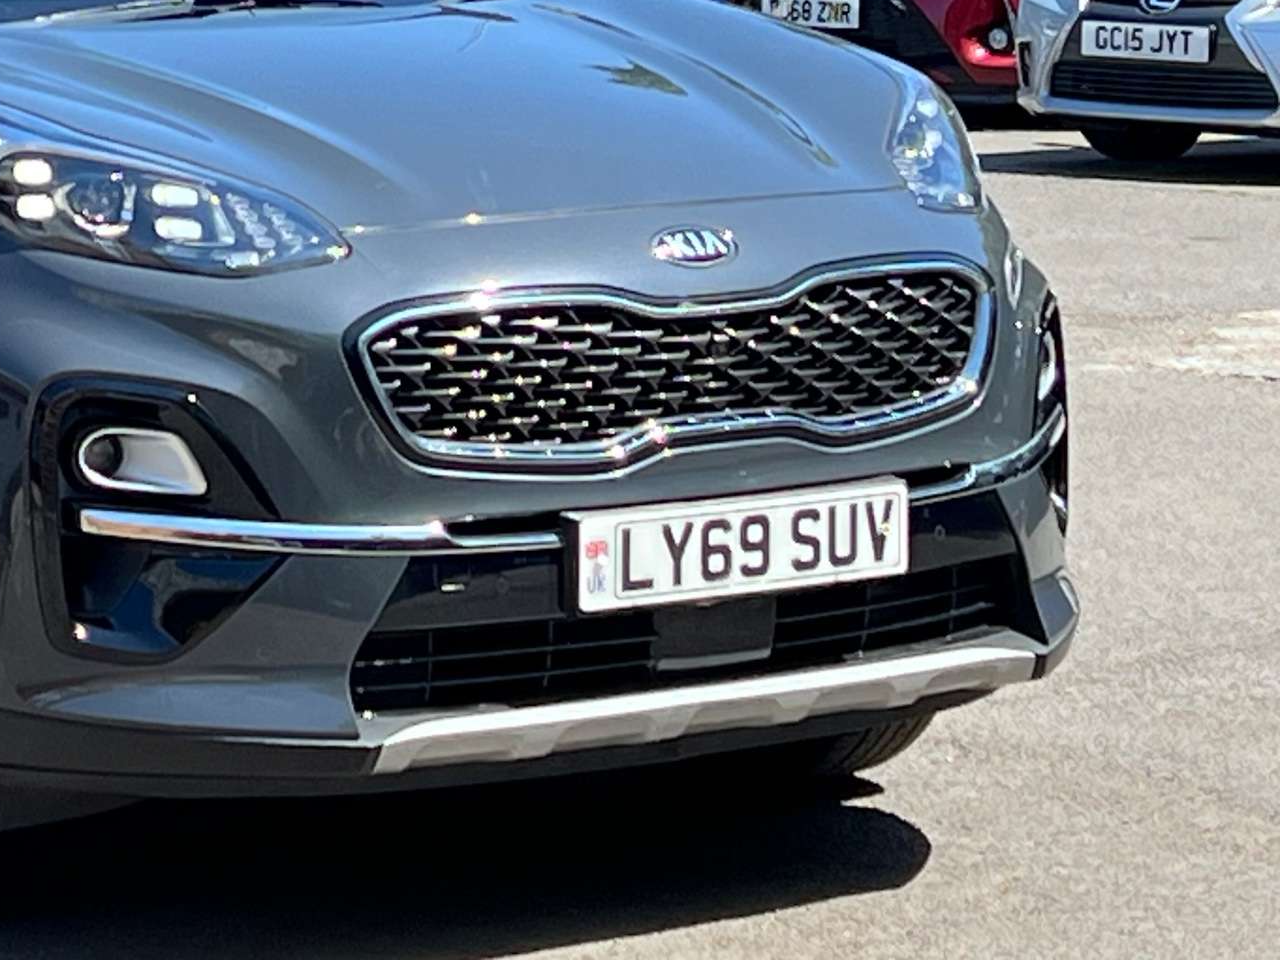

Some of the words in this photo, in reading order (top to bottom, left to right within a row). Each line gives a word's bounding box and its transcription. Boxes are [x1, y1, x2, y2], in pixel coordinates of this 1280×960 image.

[1095, 26, 1143, 51] GC15
[1150, 29, 1193, 55] JYT
[655, 229, 731, 258] KIA
[622, 514, 770, 592] LY69
[792, 499, 893, 571] SUV
